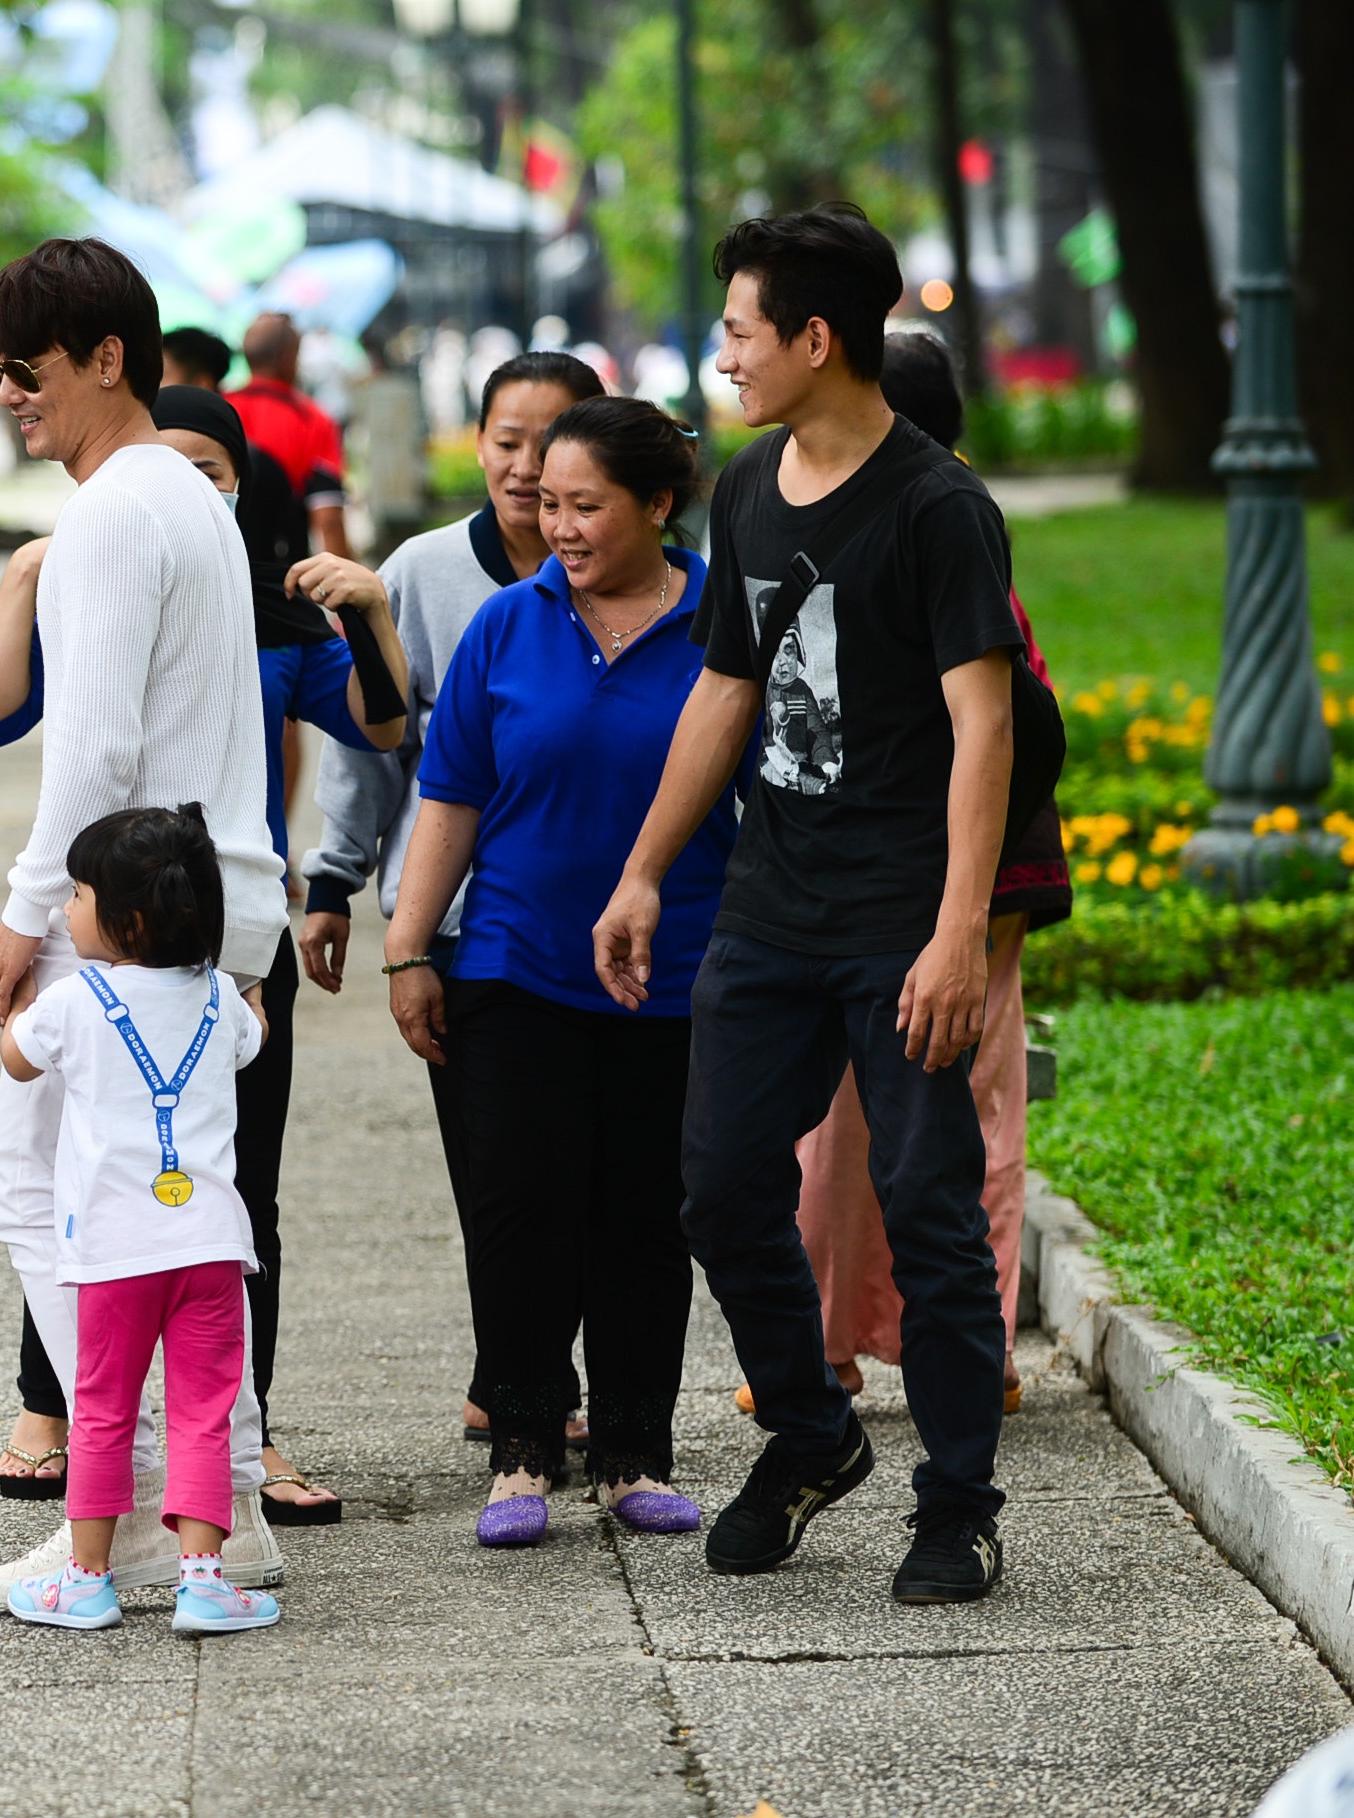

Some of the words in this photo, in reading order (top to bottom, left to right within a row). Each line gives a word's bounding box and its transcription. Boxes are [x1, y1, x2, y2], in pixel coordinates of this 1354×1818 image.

[83, 968, 115, 1005] ORAEMON
[128, 1033, 162, 1090] DORAEMON
[178, 1022, 210, 1080] DORAEMON
[160, 1123, 175, 1170] DORMON
